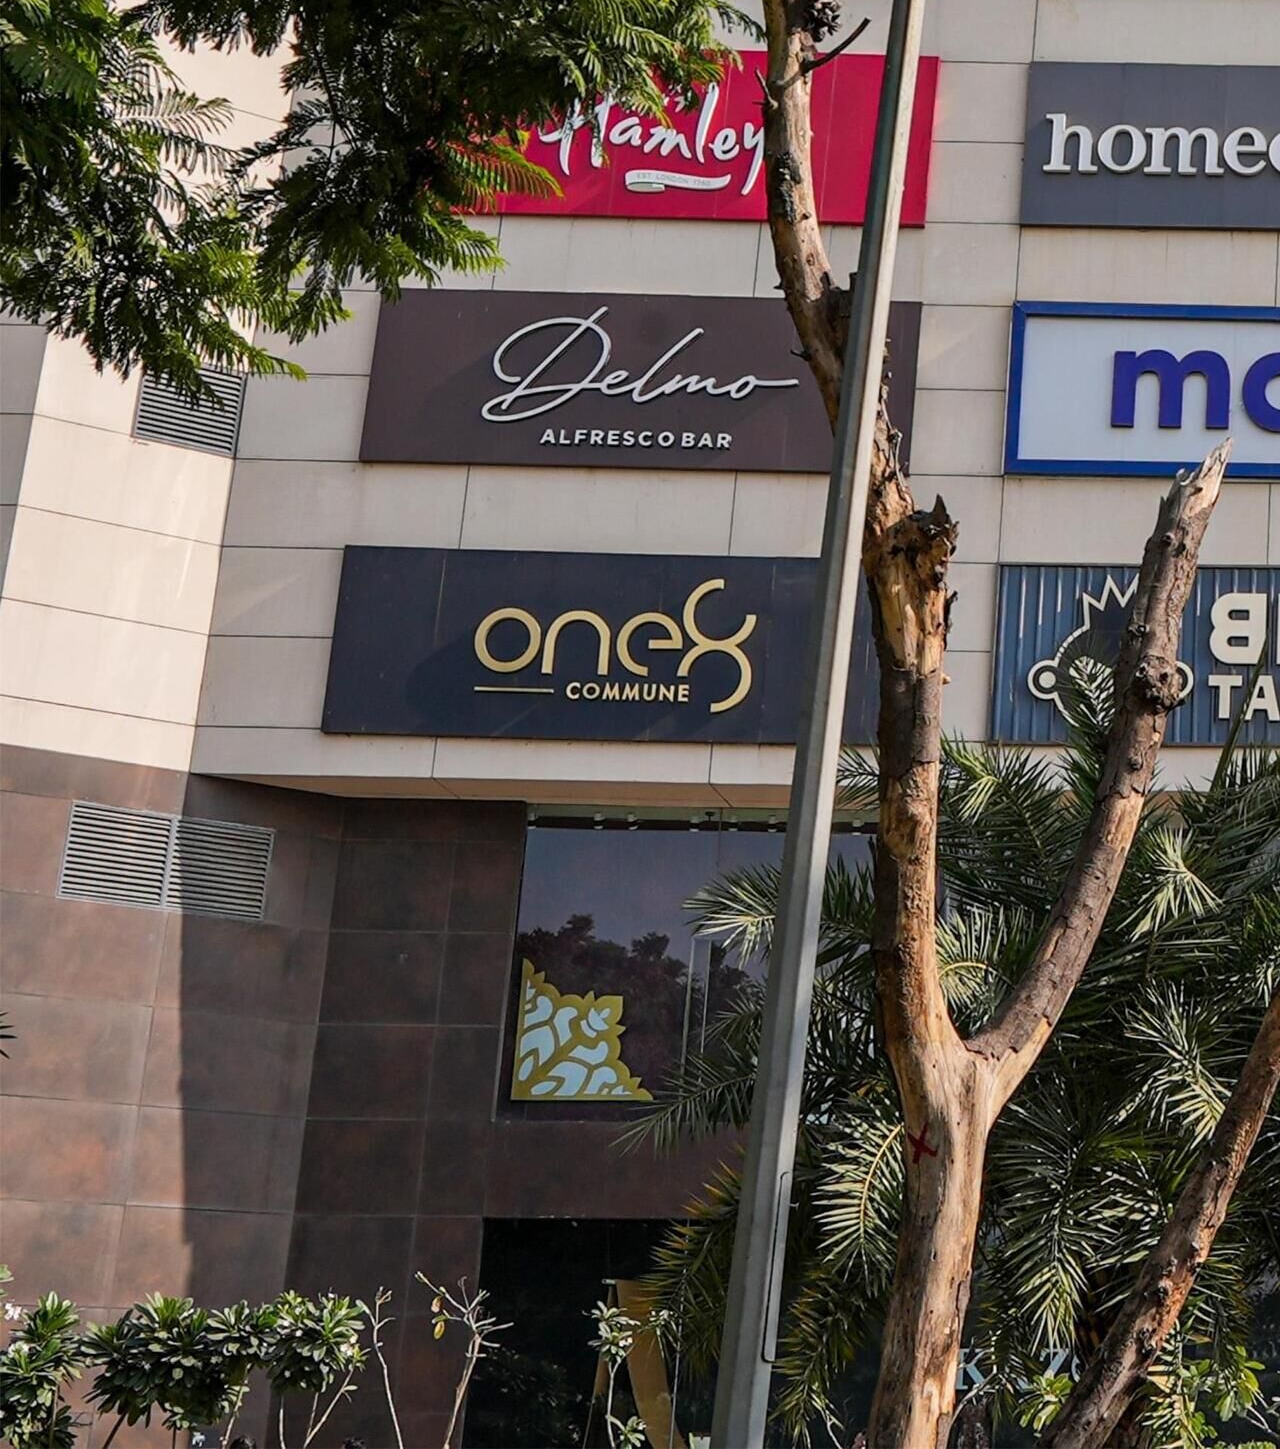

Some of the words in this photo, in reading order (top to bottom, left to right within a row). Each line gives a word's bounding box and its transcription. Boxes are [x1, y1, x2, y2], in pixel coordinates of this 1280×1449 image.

[481, 305, 799, 423] Delmo
[539, 427, 677, 450] ALFRESCO
[680, 431, 733, 451] BAR
[565, 681, 691, 704] COMMUNE
